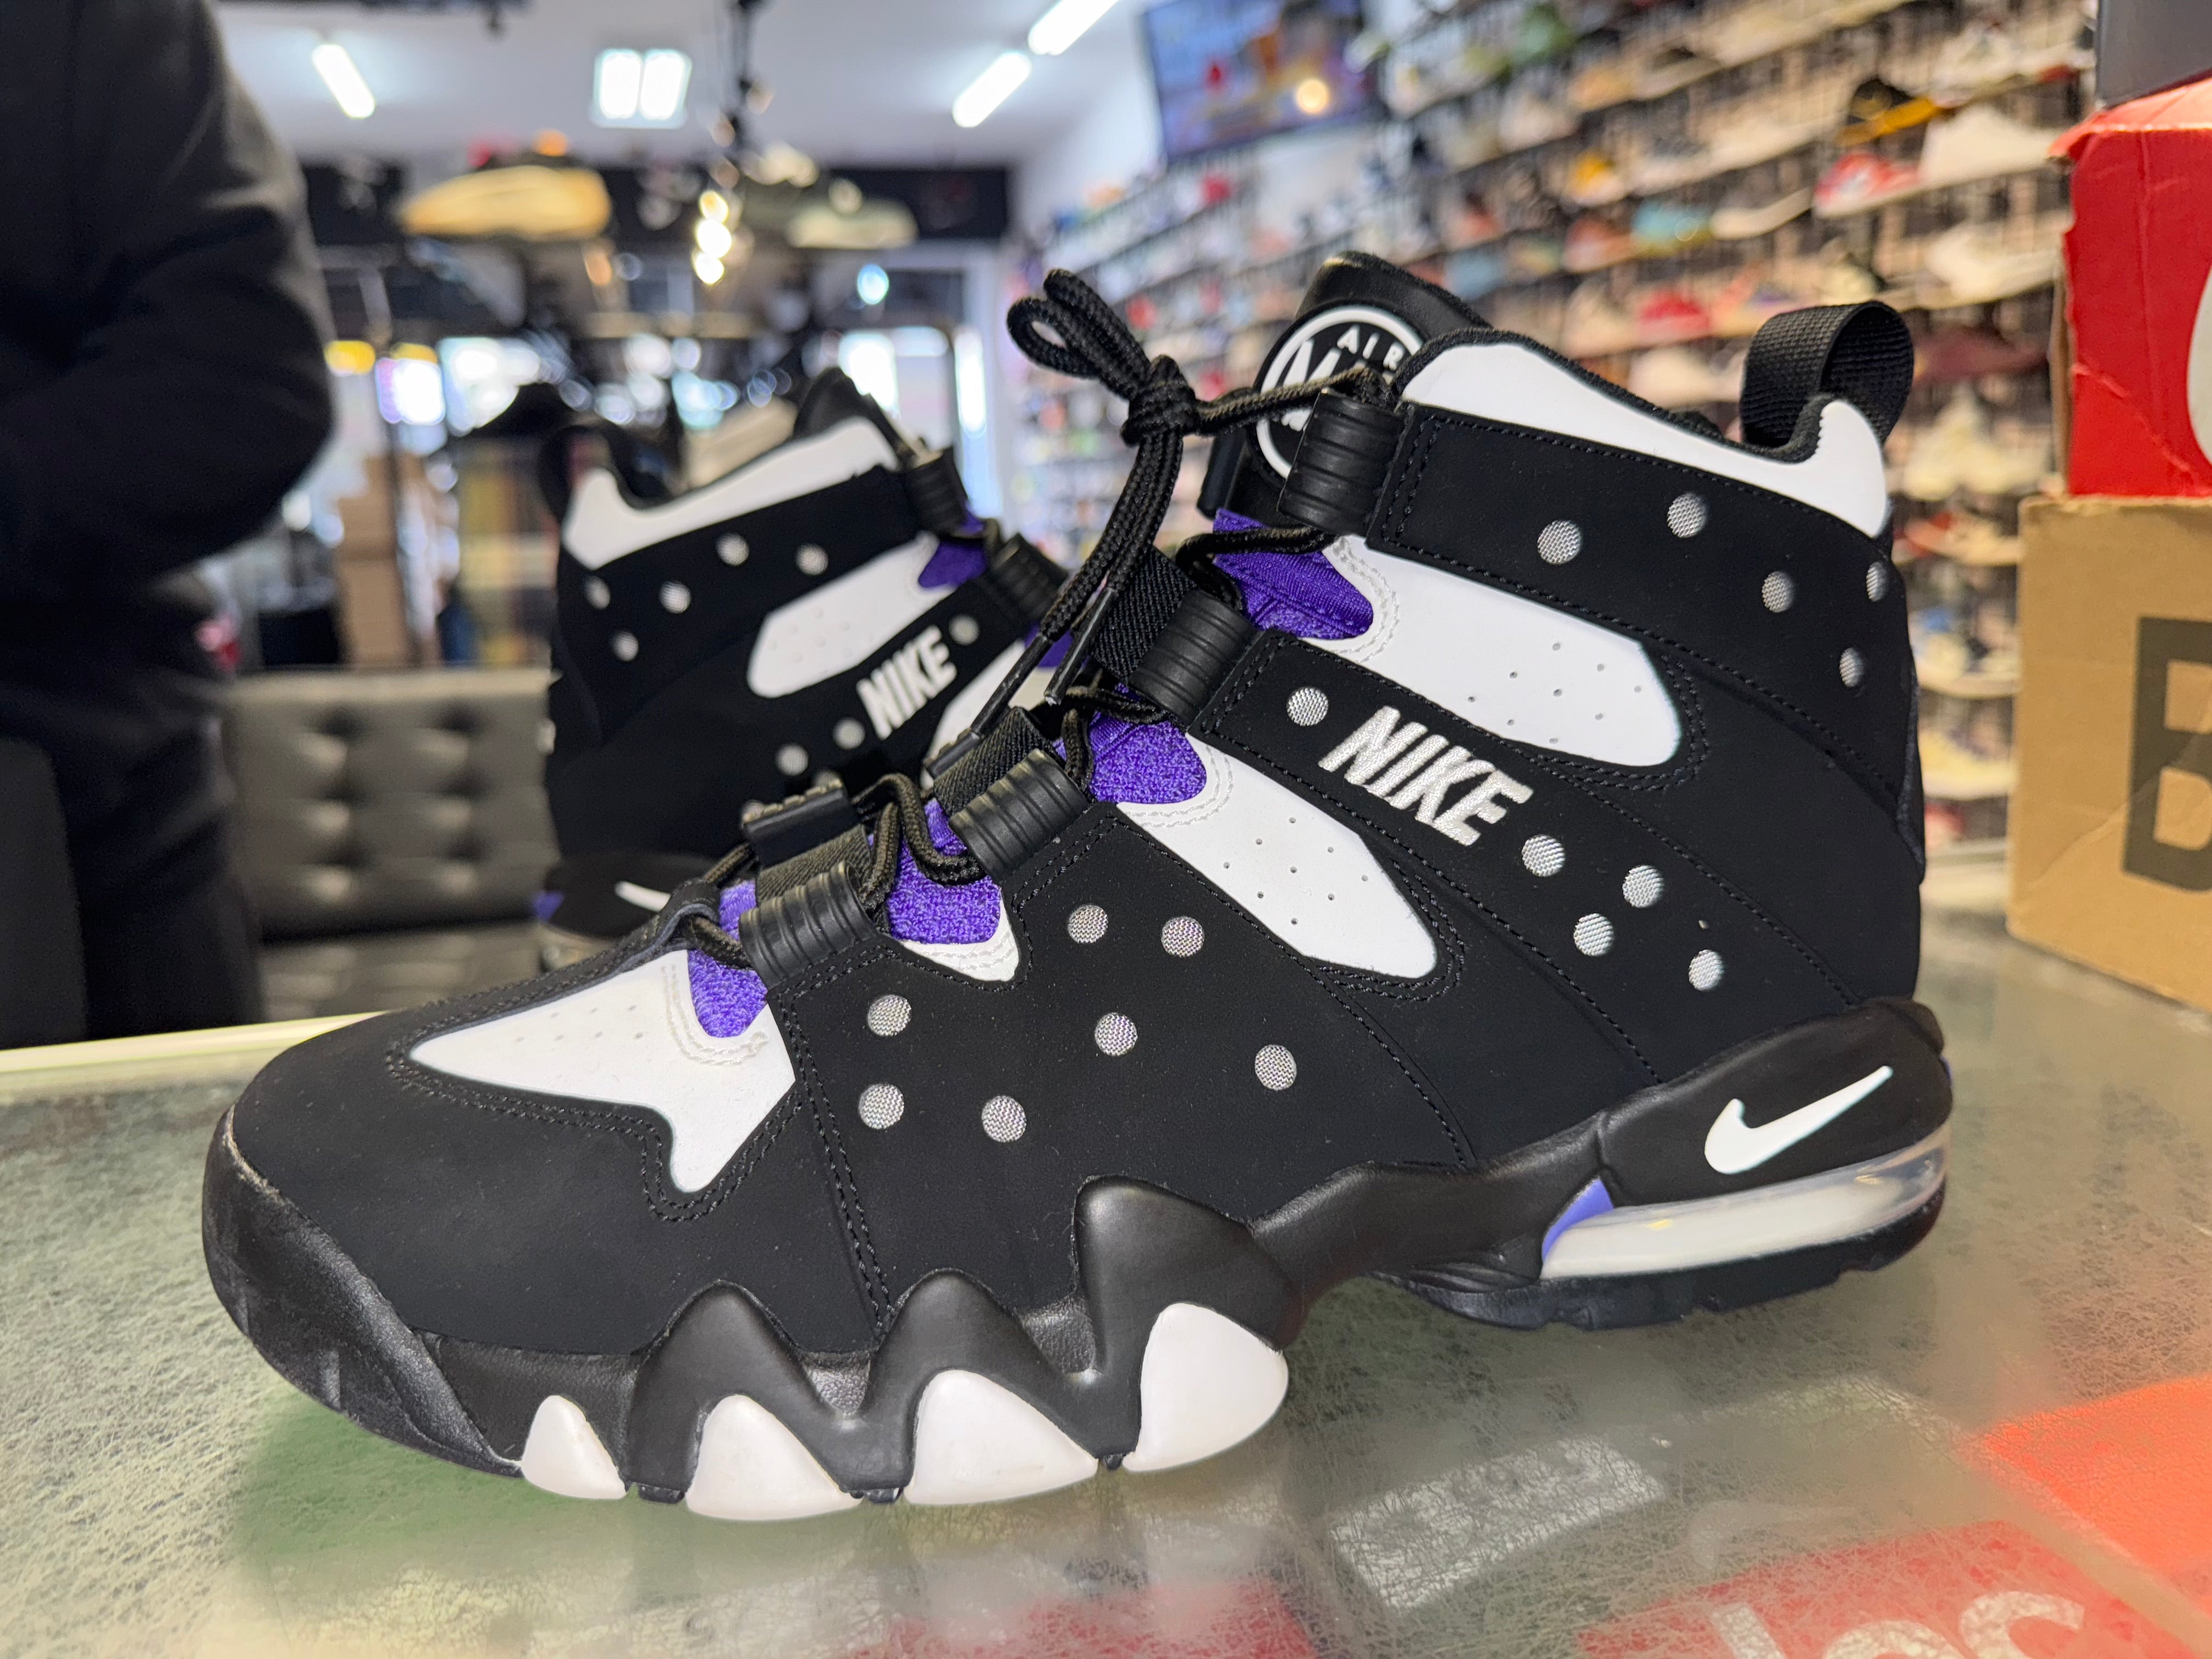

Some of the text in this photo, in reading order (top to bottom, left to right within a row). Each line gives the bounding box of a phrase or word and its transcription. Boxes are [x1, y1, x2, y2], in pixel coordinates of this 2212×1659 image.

[1337, 324, 1404, 370] AIR
[856, 624, 957, 740] NIKE
[1318, 706, 1534, 847] NIKE
